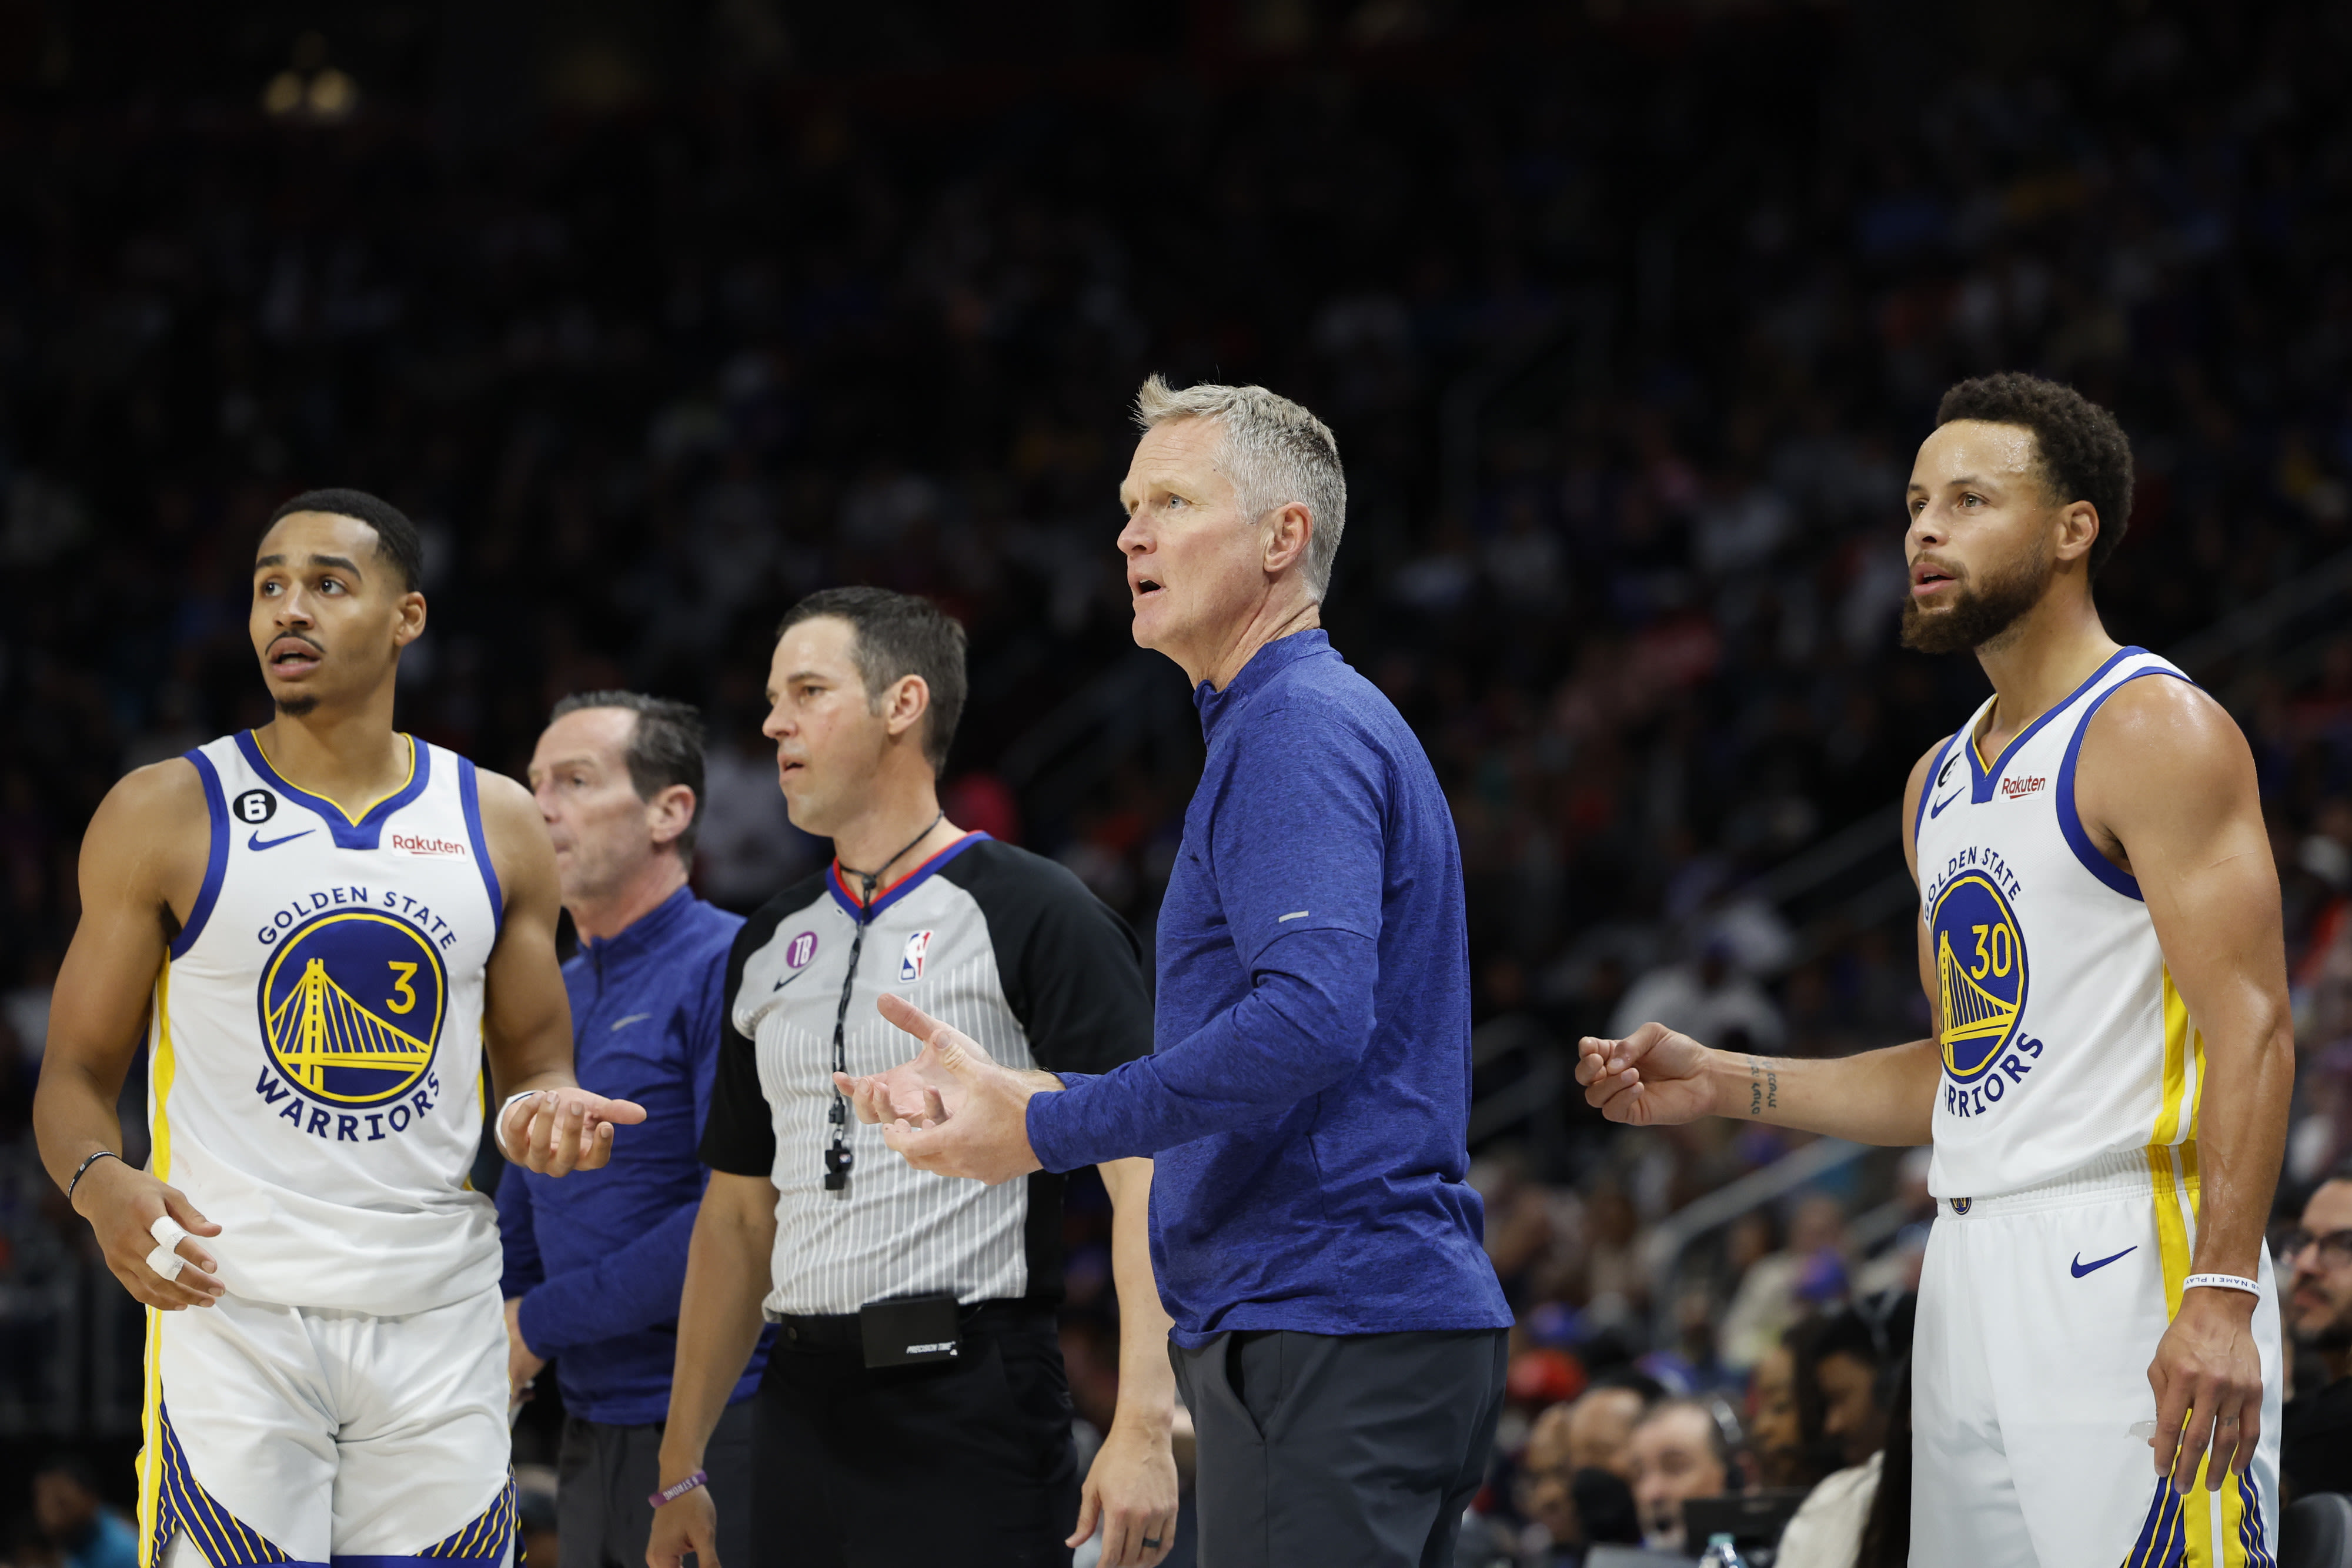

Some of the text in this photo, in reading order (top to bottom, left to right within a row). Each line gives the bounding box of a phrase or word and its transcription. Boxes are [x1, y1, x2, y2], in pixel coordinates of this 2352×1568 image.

[2002, 775, 2046, 795] Rakuten
[243, 793, 267, 821] 6
[392, 834, 465, 856] Rakuten
[1925, 845, 2022, 921] GOLDEN STATE
[258, 887, 457, 951] GOLDEN STATE
[1970, 922, 2012, 980] 30
[386, 960, 419, 1015] 3
[1944, 1032, 2043, 1118] RRIORS
[255, 1065, 440, 1142] WARRIORS
[2185, 1277, 2207, 1285] PLAY
[2219, 1277, 2248, 1287] NAME
[663, 1477, 693, 1501] STRONG
